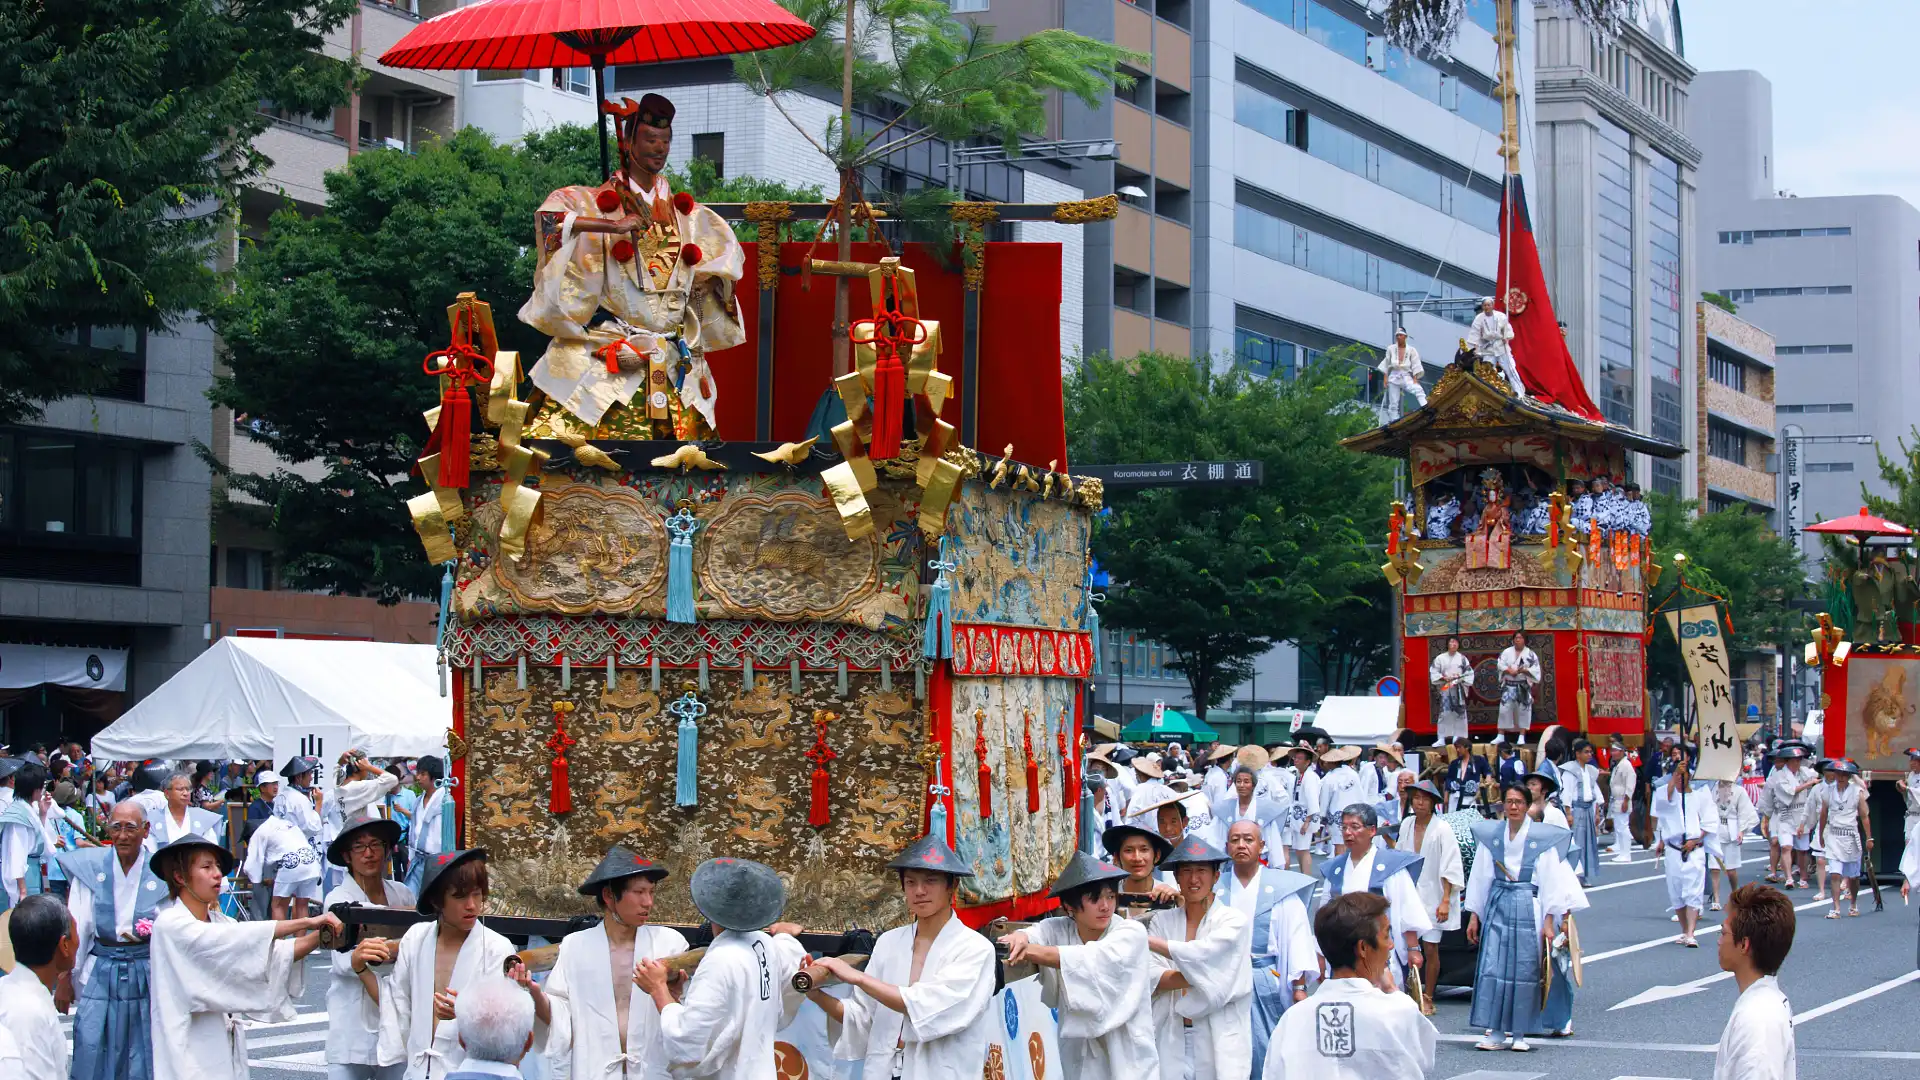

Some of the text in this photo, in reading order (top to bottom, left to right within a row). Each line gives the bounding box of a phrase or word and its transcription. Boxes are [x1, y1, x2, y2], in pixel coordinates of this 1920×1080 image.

[1113, 468, 1173, 479] Koromotana dori
[1180, 462, 1252, 481] 衣棚通
